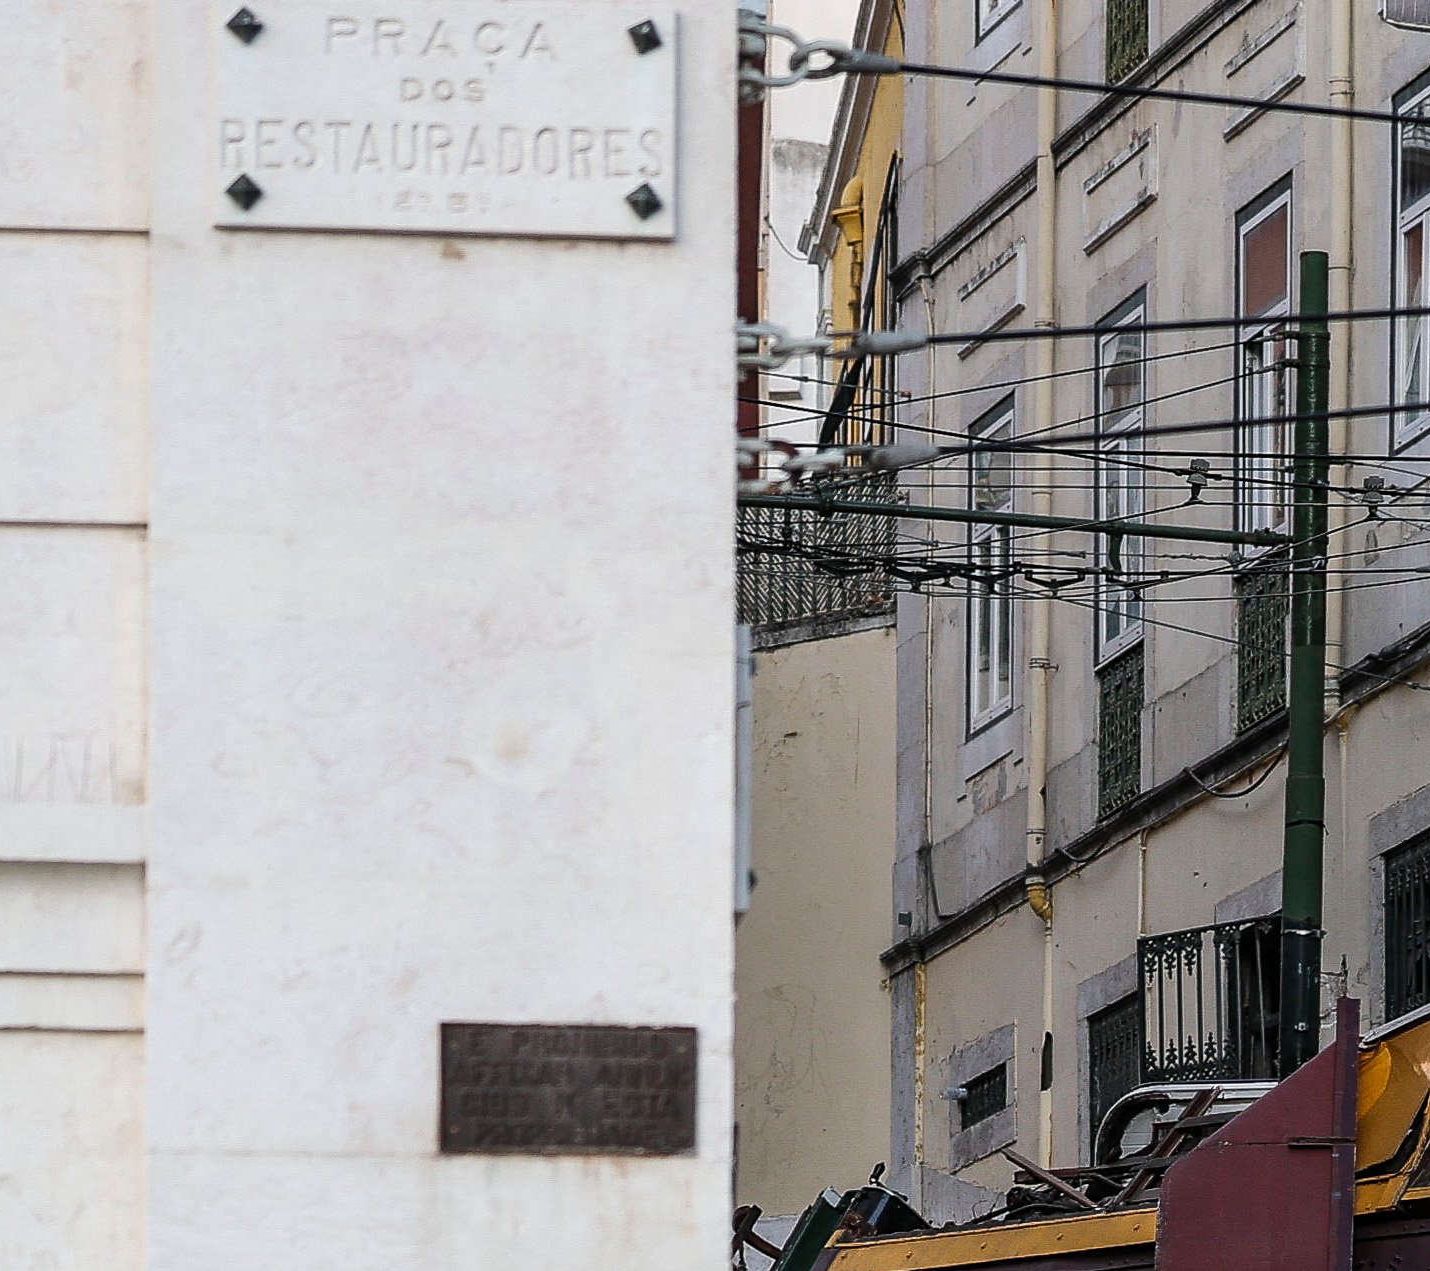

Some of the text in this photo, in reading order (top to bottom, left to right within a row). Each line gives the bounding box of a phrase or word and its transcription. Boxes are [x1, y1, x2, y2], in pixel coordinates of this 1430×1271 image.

[325, 16, 558, 73] PRAÇA
[400, 77, 486, 102] DOS
[219, 118, 663, 181] RESTAURADORES
